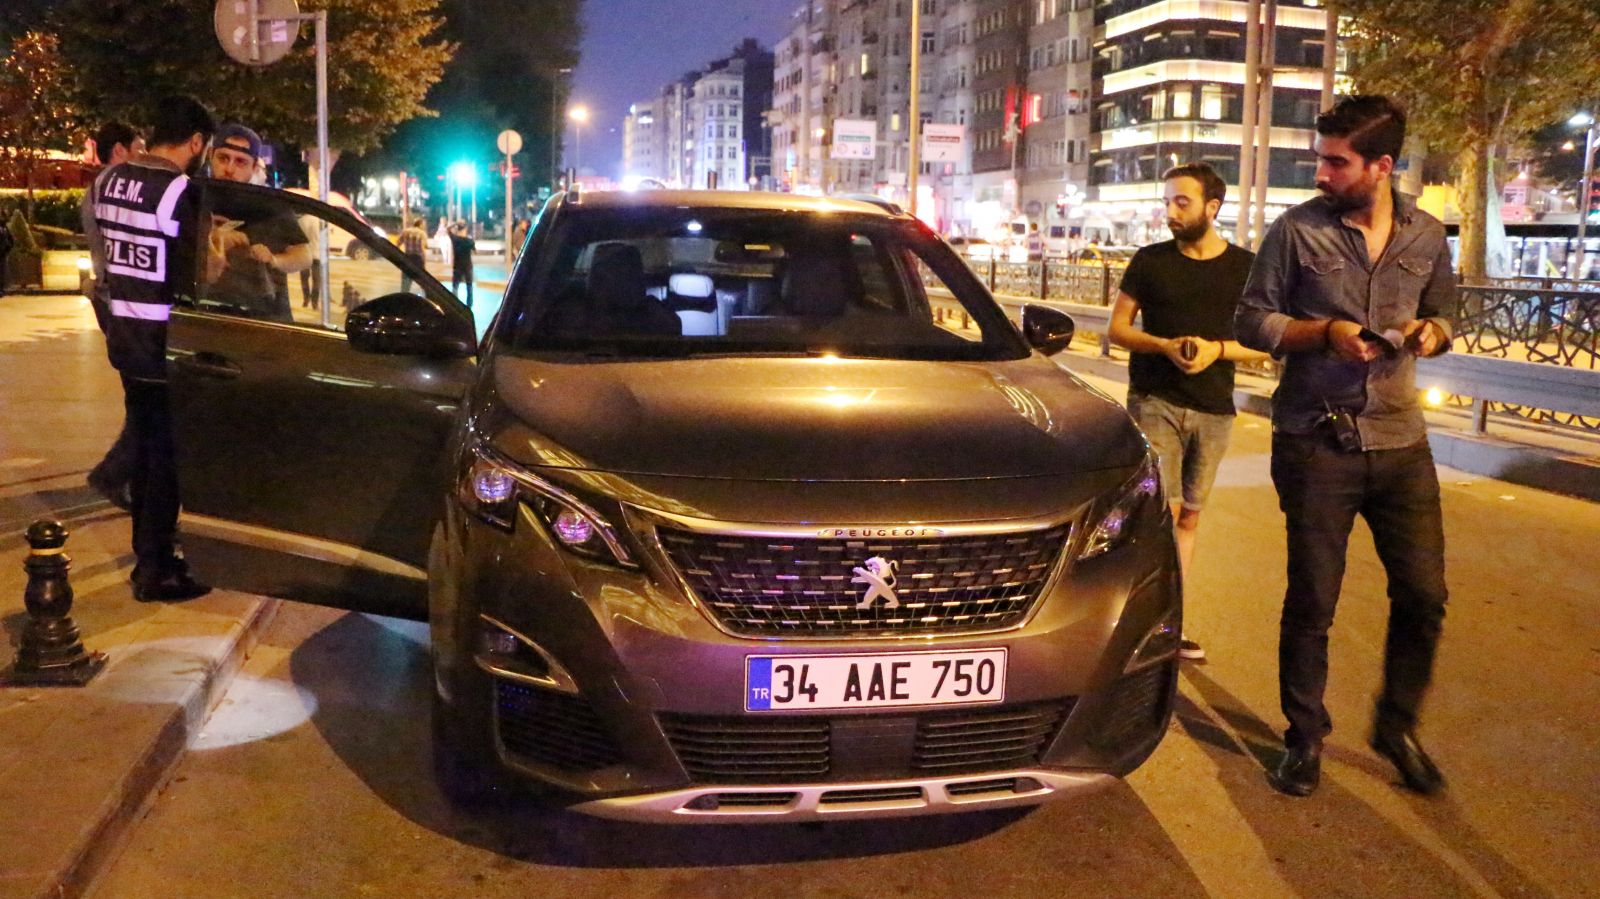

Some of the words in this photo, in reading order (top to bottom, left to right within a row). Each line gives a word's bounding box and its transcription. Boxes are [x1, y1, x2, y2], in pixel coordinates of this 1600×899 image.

[105, 240, 151, 268] OLiS
[834, 529, 927, 537] PEUGEOT
[774, 664, 818, 703] 34
[843, 662, 911, 702] AAE
[931, 658, 995, 699] 750
[752, 688, 770, 700] TR
